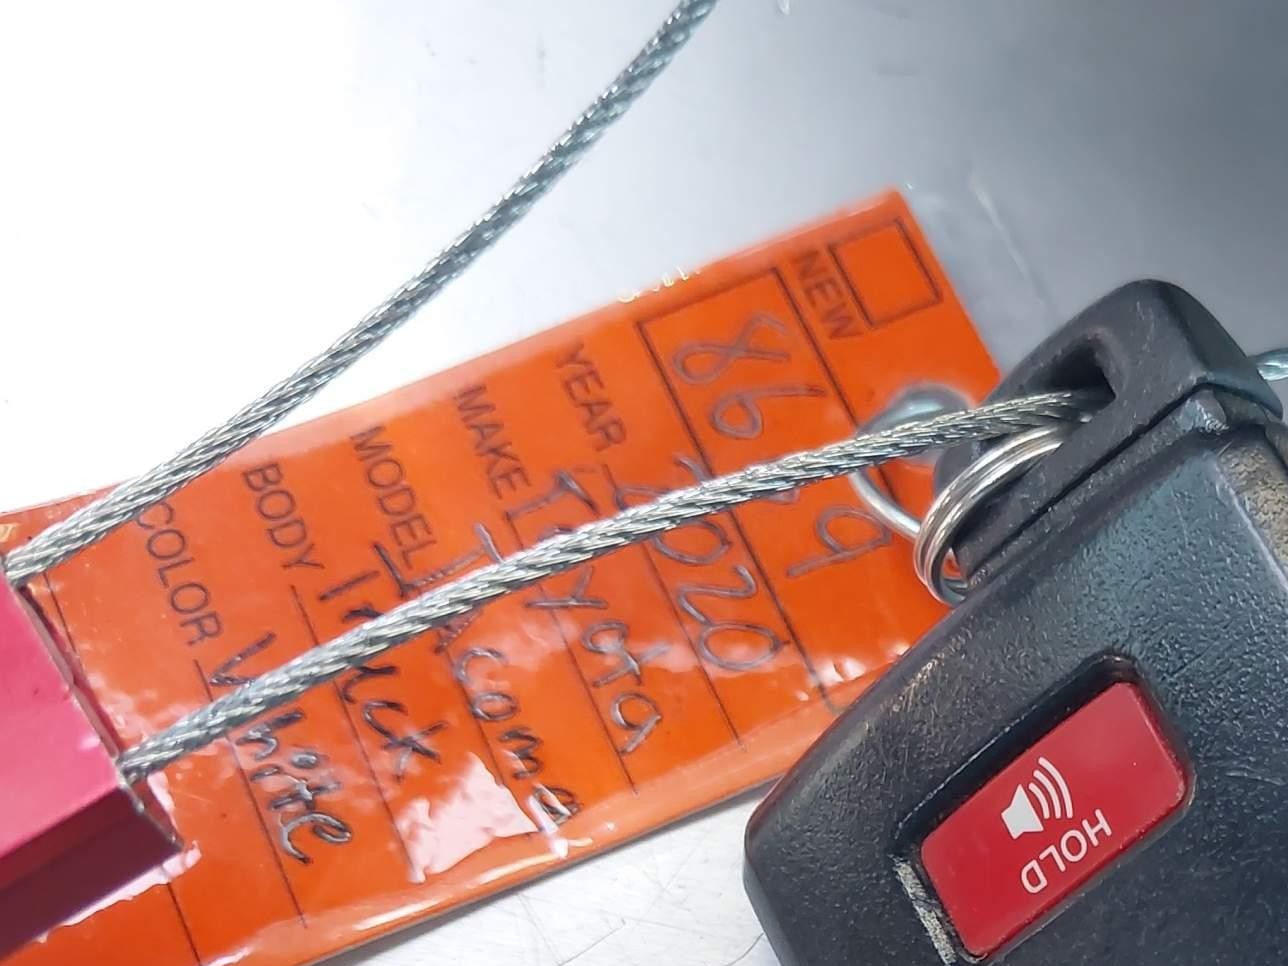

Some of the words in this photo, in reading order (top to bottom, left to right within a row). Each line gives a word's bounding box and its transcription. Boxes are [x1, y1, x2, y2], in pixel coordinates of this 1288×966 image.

[790, 249, 864, 341] NEW
[453, 384, 531, 499] MAKE
[555, 342, 627, 453] YEAR
[671, 310, 895, 578] 869
[241, 461, 326, 572] BODY
[350, 424, 437, 570] MODEL
[135, 501, 223, 647] COLOR
[505, 468, 671, 754] Tyota
[1020, 808, 1113, 894] HOLD
